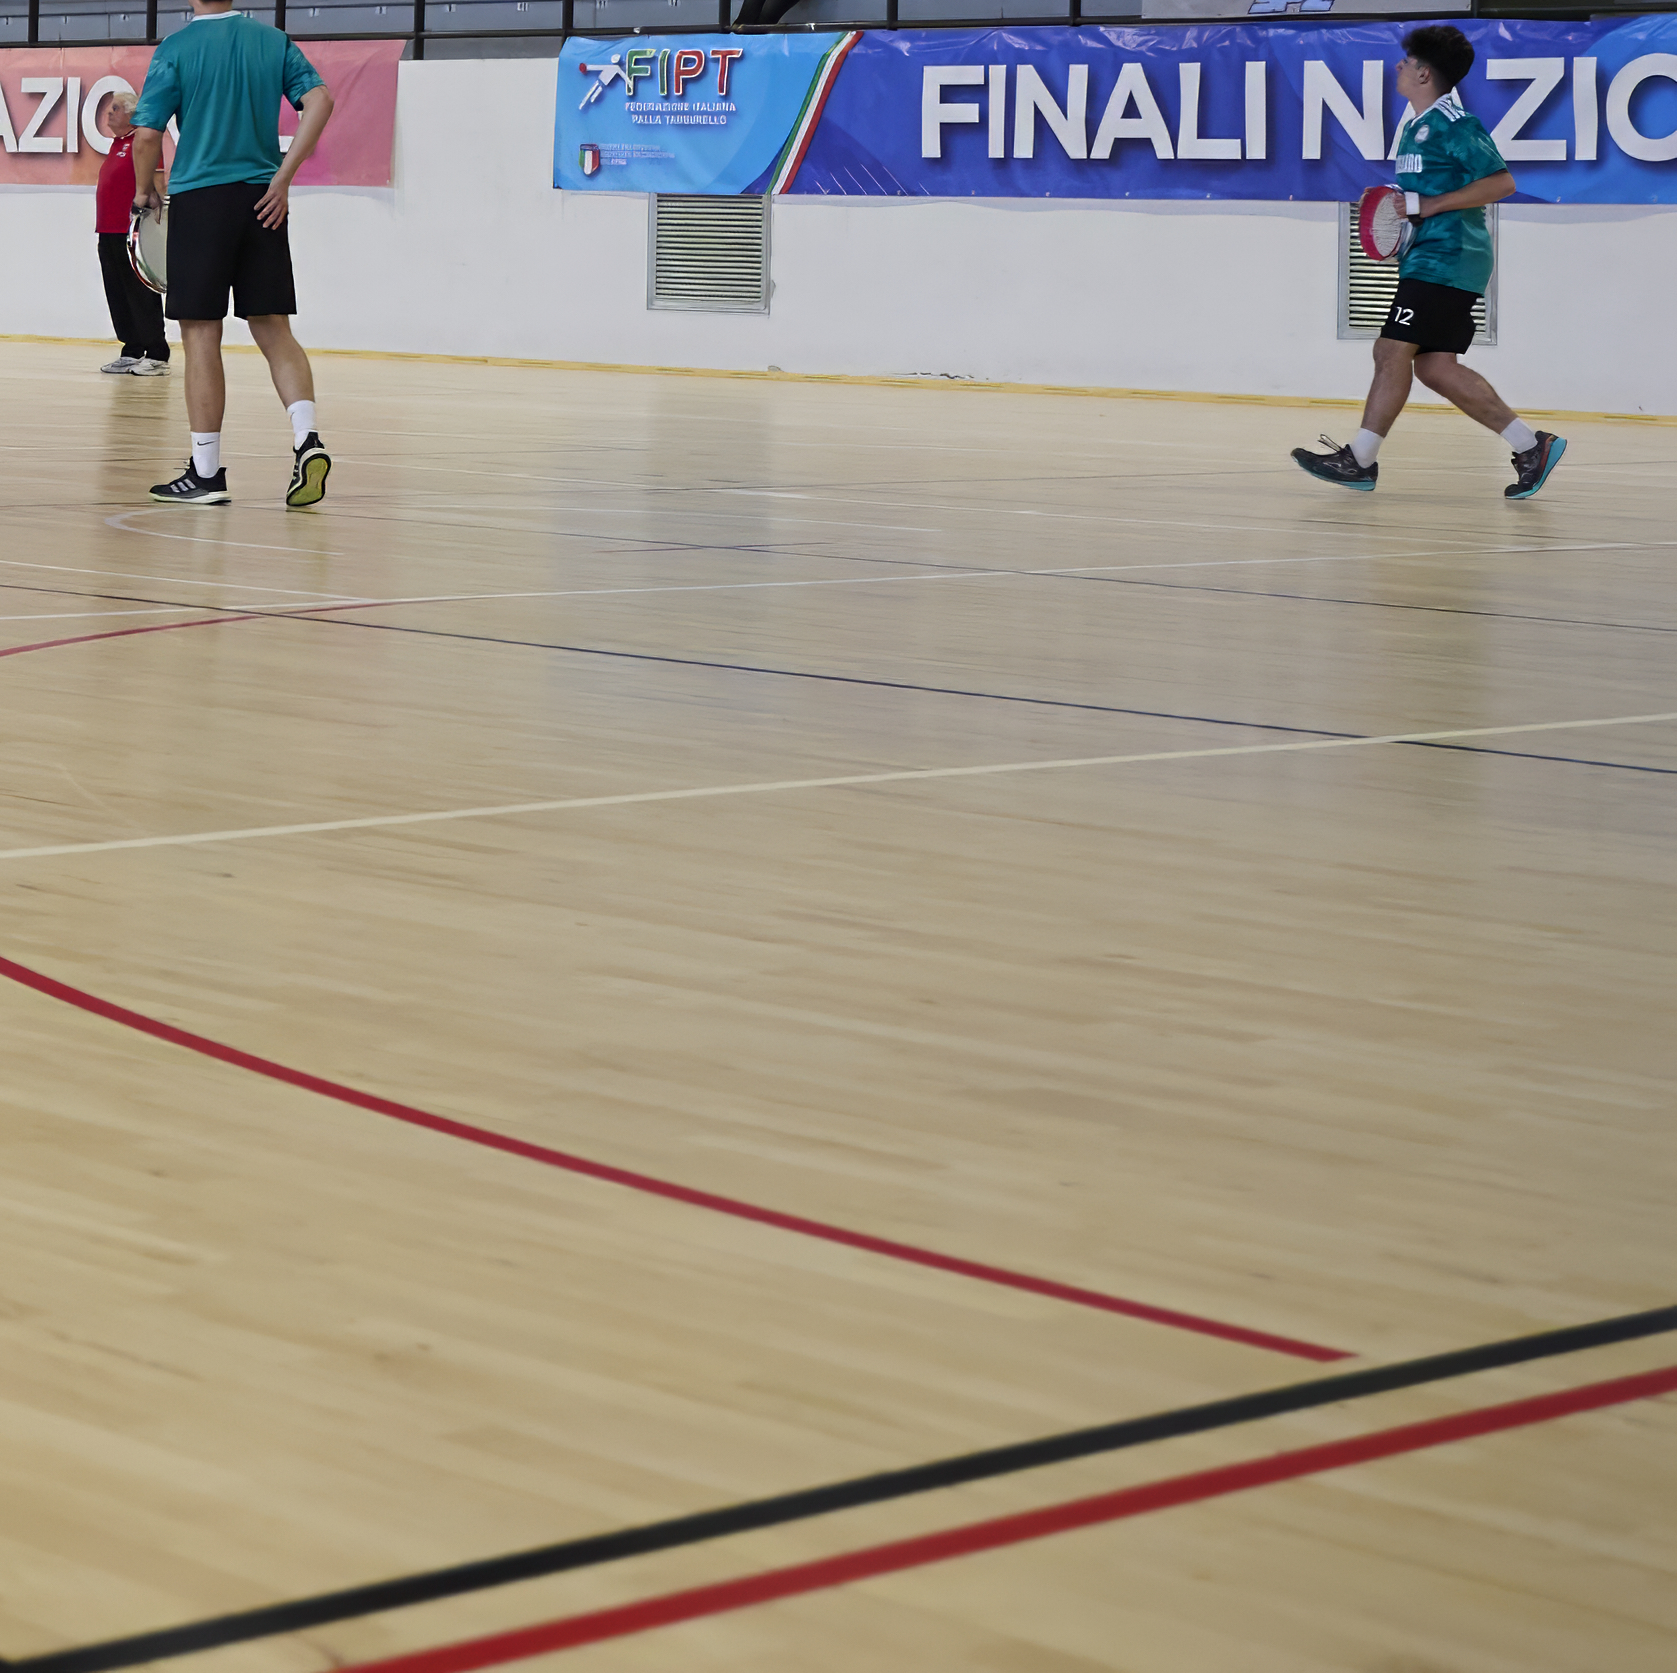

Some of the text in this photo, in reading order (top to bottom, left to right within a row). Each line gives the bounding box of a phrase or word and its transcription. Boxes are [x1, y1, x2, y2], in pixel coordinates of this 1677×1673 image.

[625, 48, 744, 96] FIPT
[921, 52, 1677, 162] FINALI NZIO
[1393, 306, 1415, 326] 12
